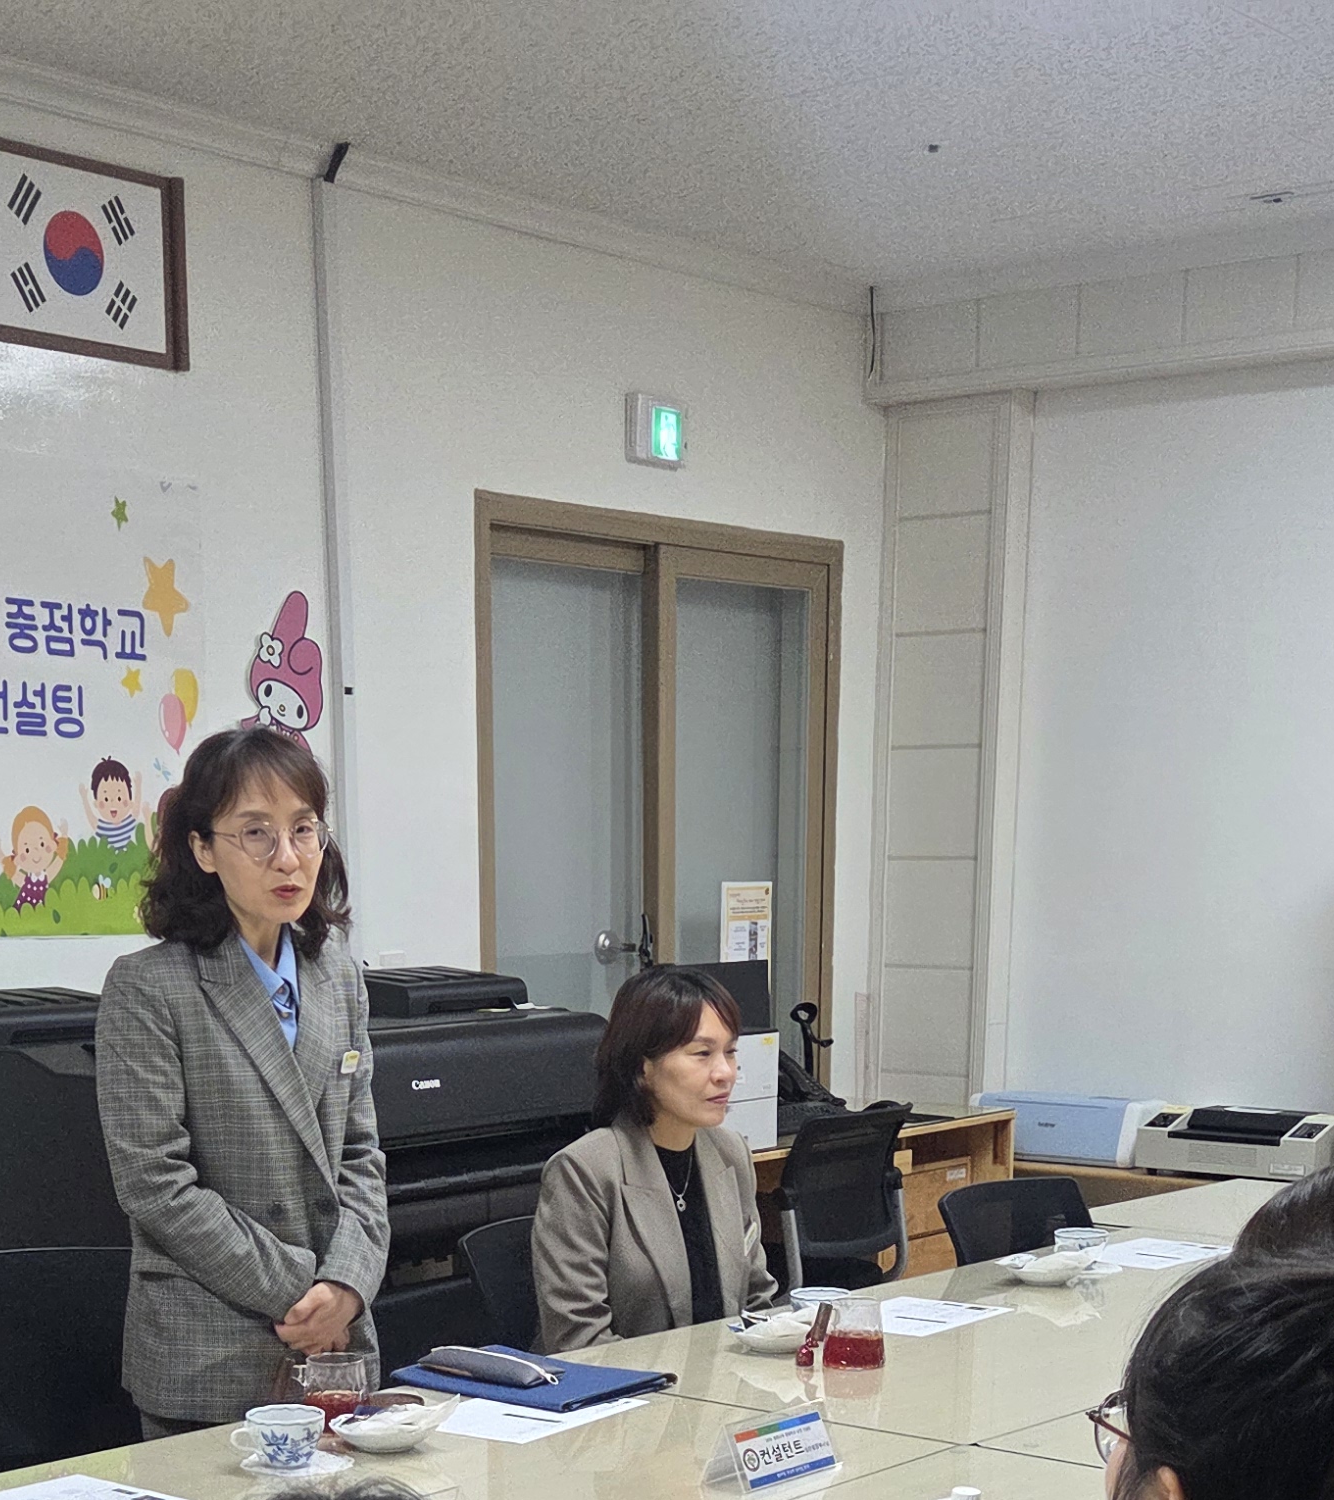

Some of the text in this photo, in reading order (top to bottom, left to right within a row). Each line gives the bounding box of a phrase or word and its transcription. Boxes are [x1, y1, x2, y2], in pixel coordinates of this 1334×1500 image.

[4, 595, 147, 662] 중점학교
[411, 1079, 441, 1091] Canon
[759, 1440, 805, 1465] 컨설턴트
